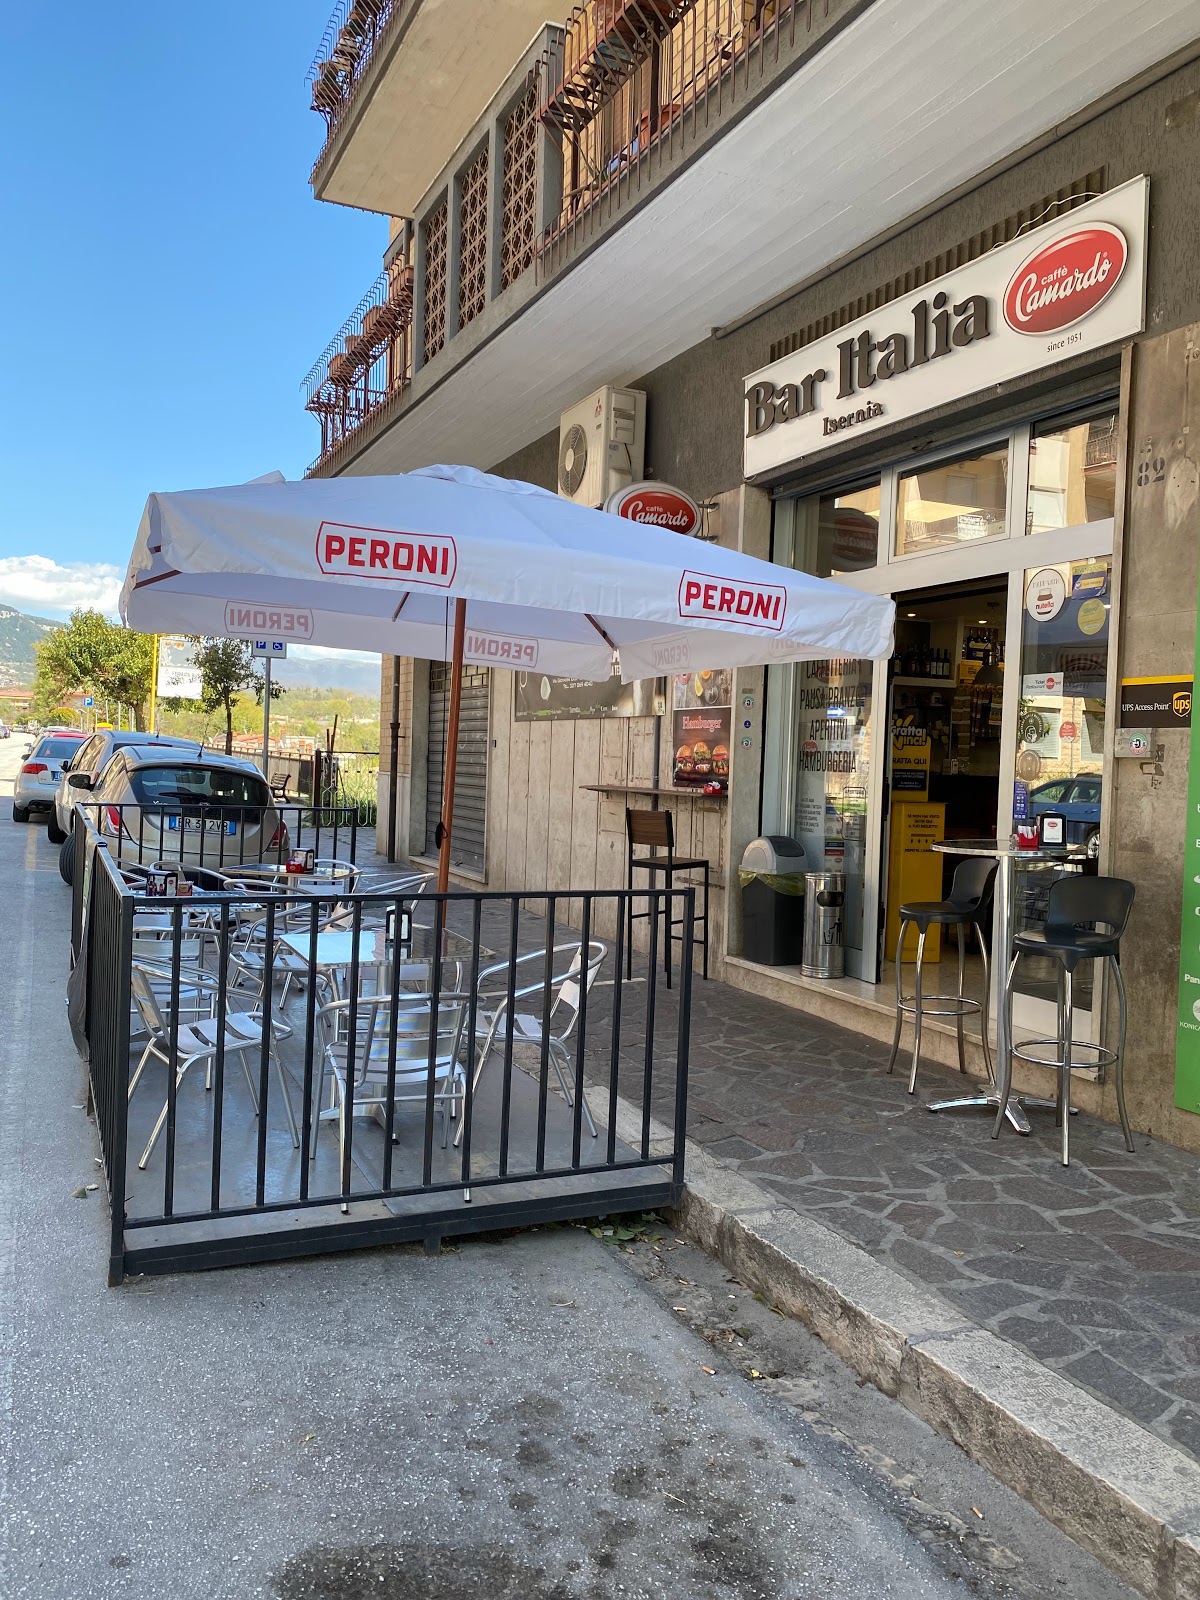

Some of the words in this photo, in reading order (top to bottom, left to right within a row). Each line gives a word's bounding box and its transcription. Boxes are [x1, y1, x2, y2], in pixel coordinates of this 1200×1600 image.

[1041, 265, 1069, 286] caffè
[1046, 338, 1066, 353] since
[1066, 331, 1083, 346] 1951
[744, 368, 827, 438] Bar
[836, 291, 991, 399] Italia
[822, 400, 884, 437] Isernia
[1136, 456, 1166, 487] 82
[324, 534, 449, 575] PERONI
[684, 580, 782, 621] PERONI
[1035, 601, 1055, 610] nutella
[84, 697, 92, 706] P
[800, 688, 824, 710] PAUSA
[1122, 703, 1134, 712] UPS
[1134, 703, 1154, 711] Access
[1174, 699, 1190, 714] ups
[682, 715, 723, 733] Hamburger
[799, 750, 857, 773] HAMBURGERIA
[892, 757, 912, 765] RATTA
[913, 757, 927, 765] QUI
